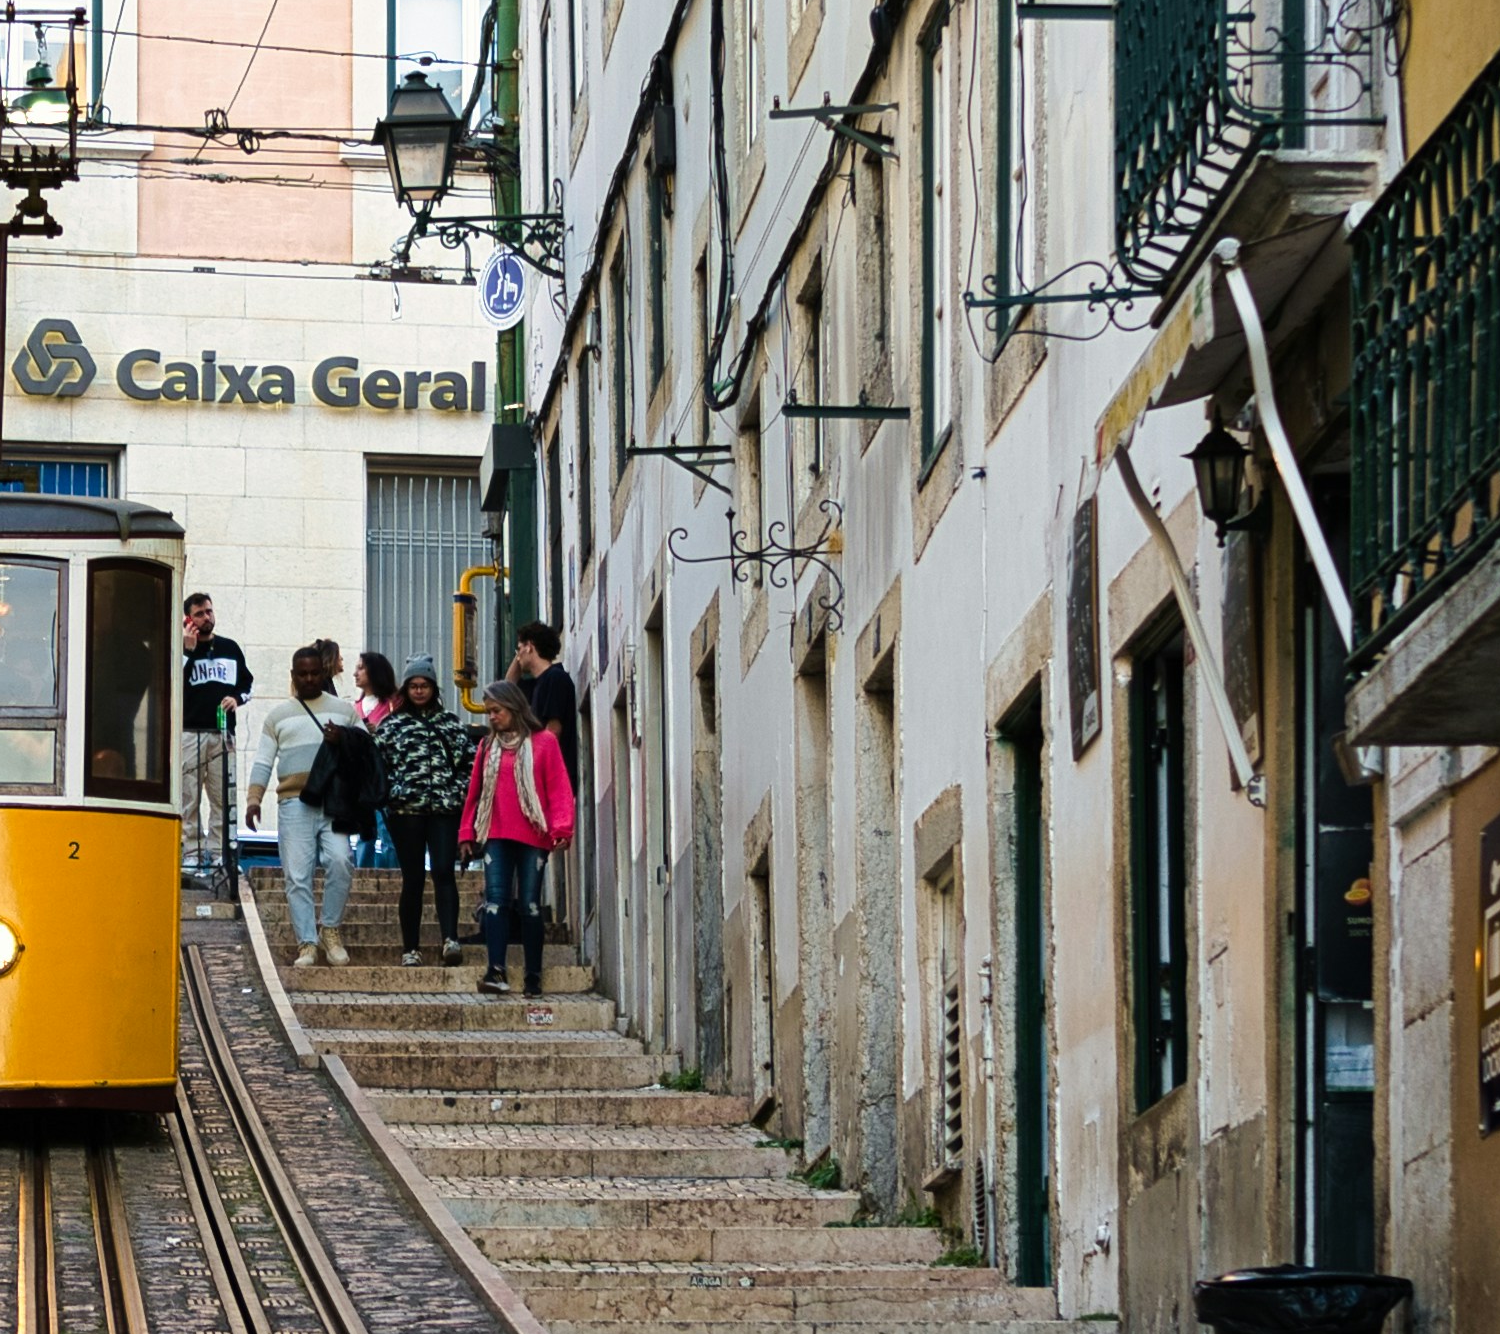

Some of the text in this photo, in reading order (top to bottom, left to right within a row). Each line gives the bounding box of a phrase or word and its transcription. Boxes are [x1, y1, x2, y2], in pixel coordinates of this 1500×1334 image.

[116, 348, 487, 413] Caixa Geral
[68, 841, 80, 860] 2
